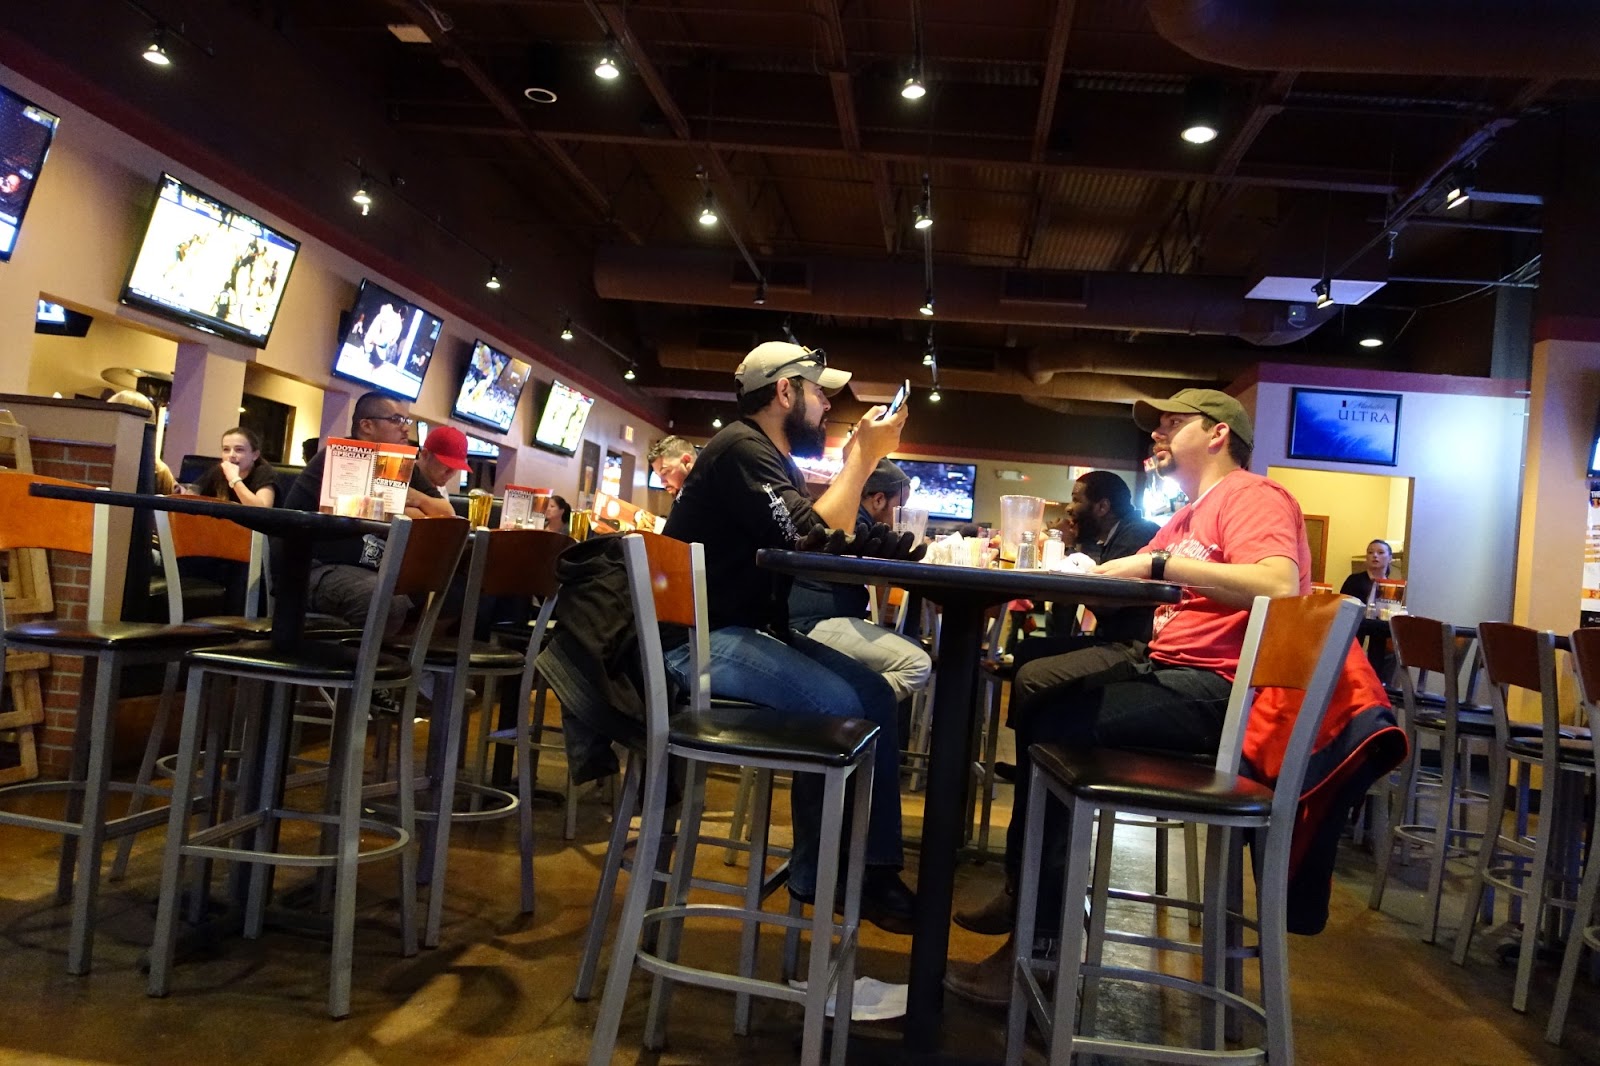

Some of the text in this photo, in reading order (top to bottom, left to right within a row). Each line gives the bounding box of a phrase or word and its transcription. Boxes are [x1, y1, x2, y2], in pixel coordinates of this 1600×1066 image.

[1338, 410, 1391, 423] ULTRA
[331, 444, 374, 454] FOOTBALL
[331, 450, 373, 460] SPECIALS
[373, 478, 407, 489] CERVEZA
